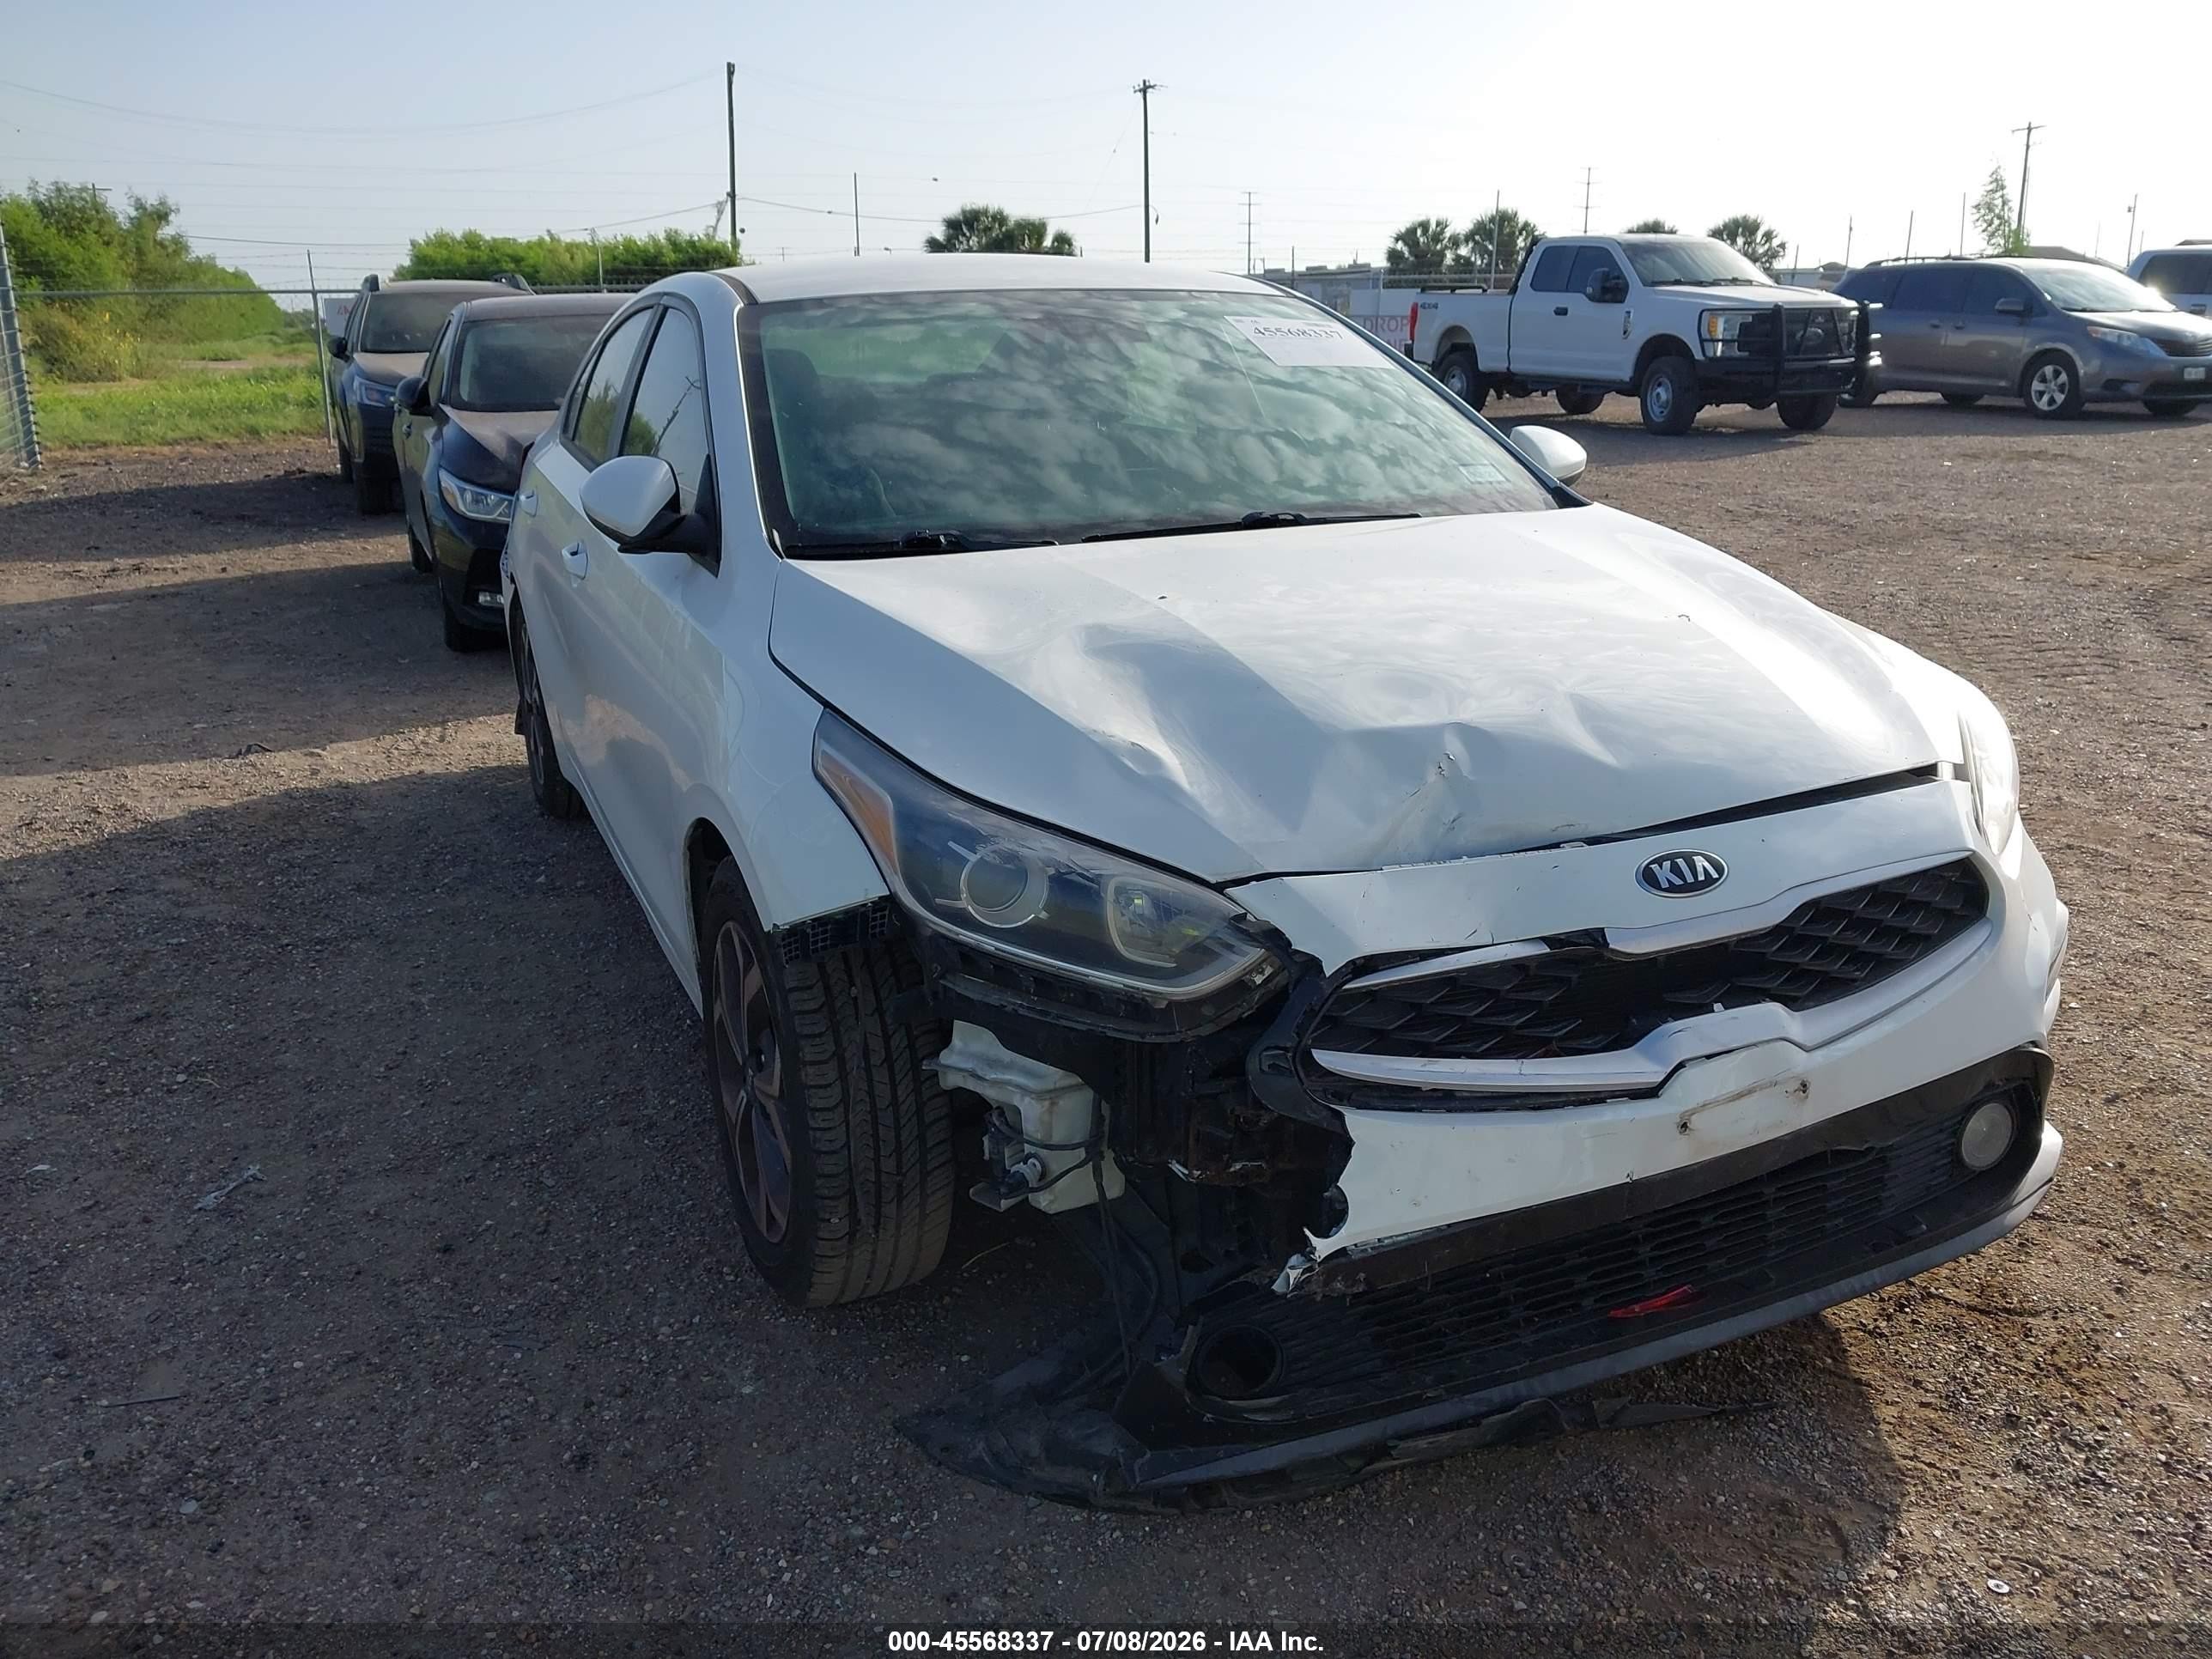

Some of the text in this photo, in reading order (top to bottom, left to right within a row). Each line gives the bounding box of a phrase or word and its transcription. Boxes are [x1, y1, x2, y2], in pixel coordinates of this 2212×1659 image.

[1364, 316, 1409, 332] DROP
[1253, 326, 1343, 340] 45568337
[1649, 855, 1719, 889] KIA
